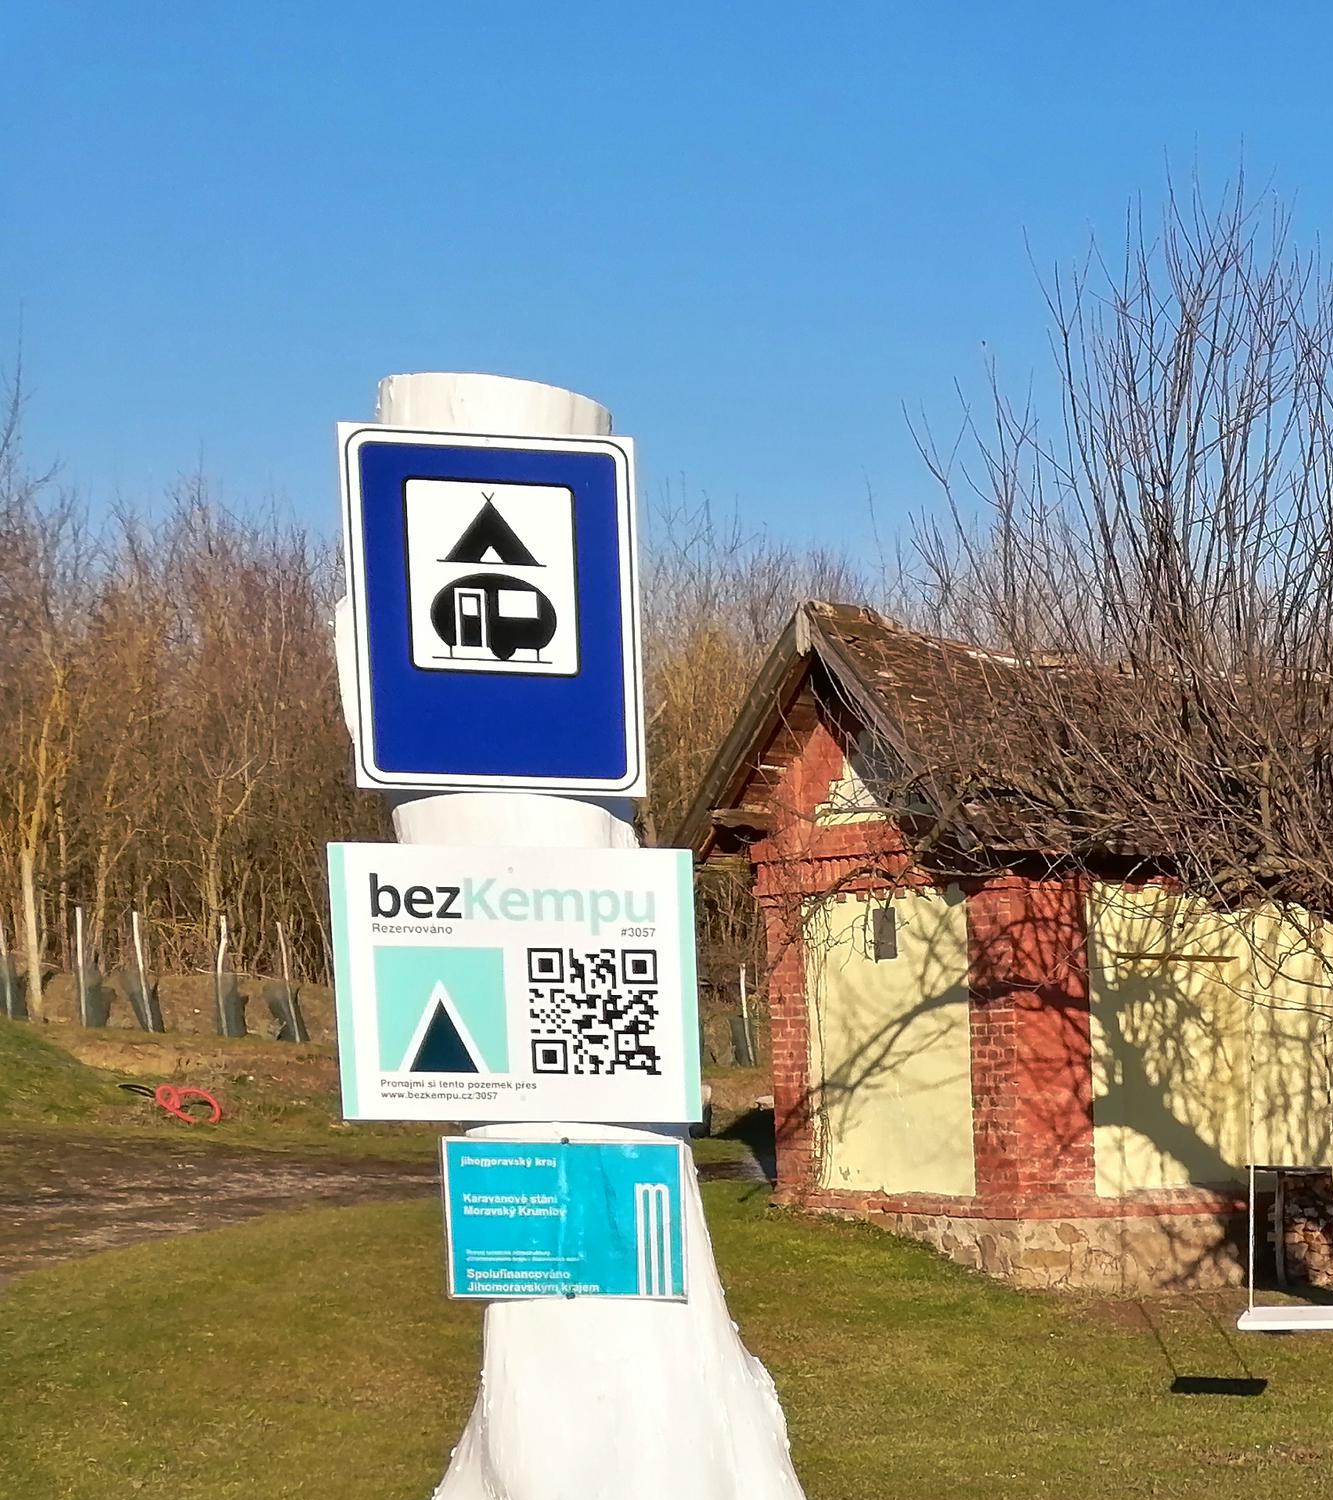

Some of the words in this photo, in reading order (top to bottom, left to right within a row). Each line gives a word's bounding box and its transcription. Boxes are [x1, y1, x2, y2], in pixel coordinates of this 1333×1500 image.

[369, 872, 656, 936] bezKempu
[371, 922, 453, 935] Rezervováno
[620, 927, 656, 938] #3057
[380, 1079, 425, 1089] Pronajmi
[427, 1079, 436, 1088] si
[439, 1080, 464, 1089] tento
[467, 1080, 512, 1090] pozemek
[515, 1080, 537, 1091] přes
[460, 1156, 532, 1168] jihomoravský
[535, 1157, 557, 1168] kraj
[463, 1205, 516, 1218] Moravský
[466, 1268, 571, 1280] Spolufinancováno
